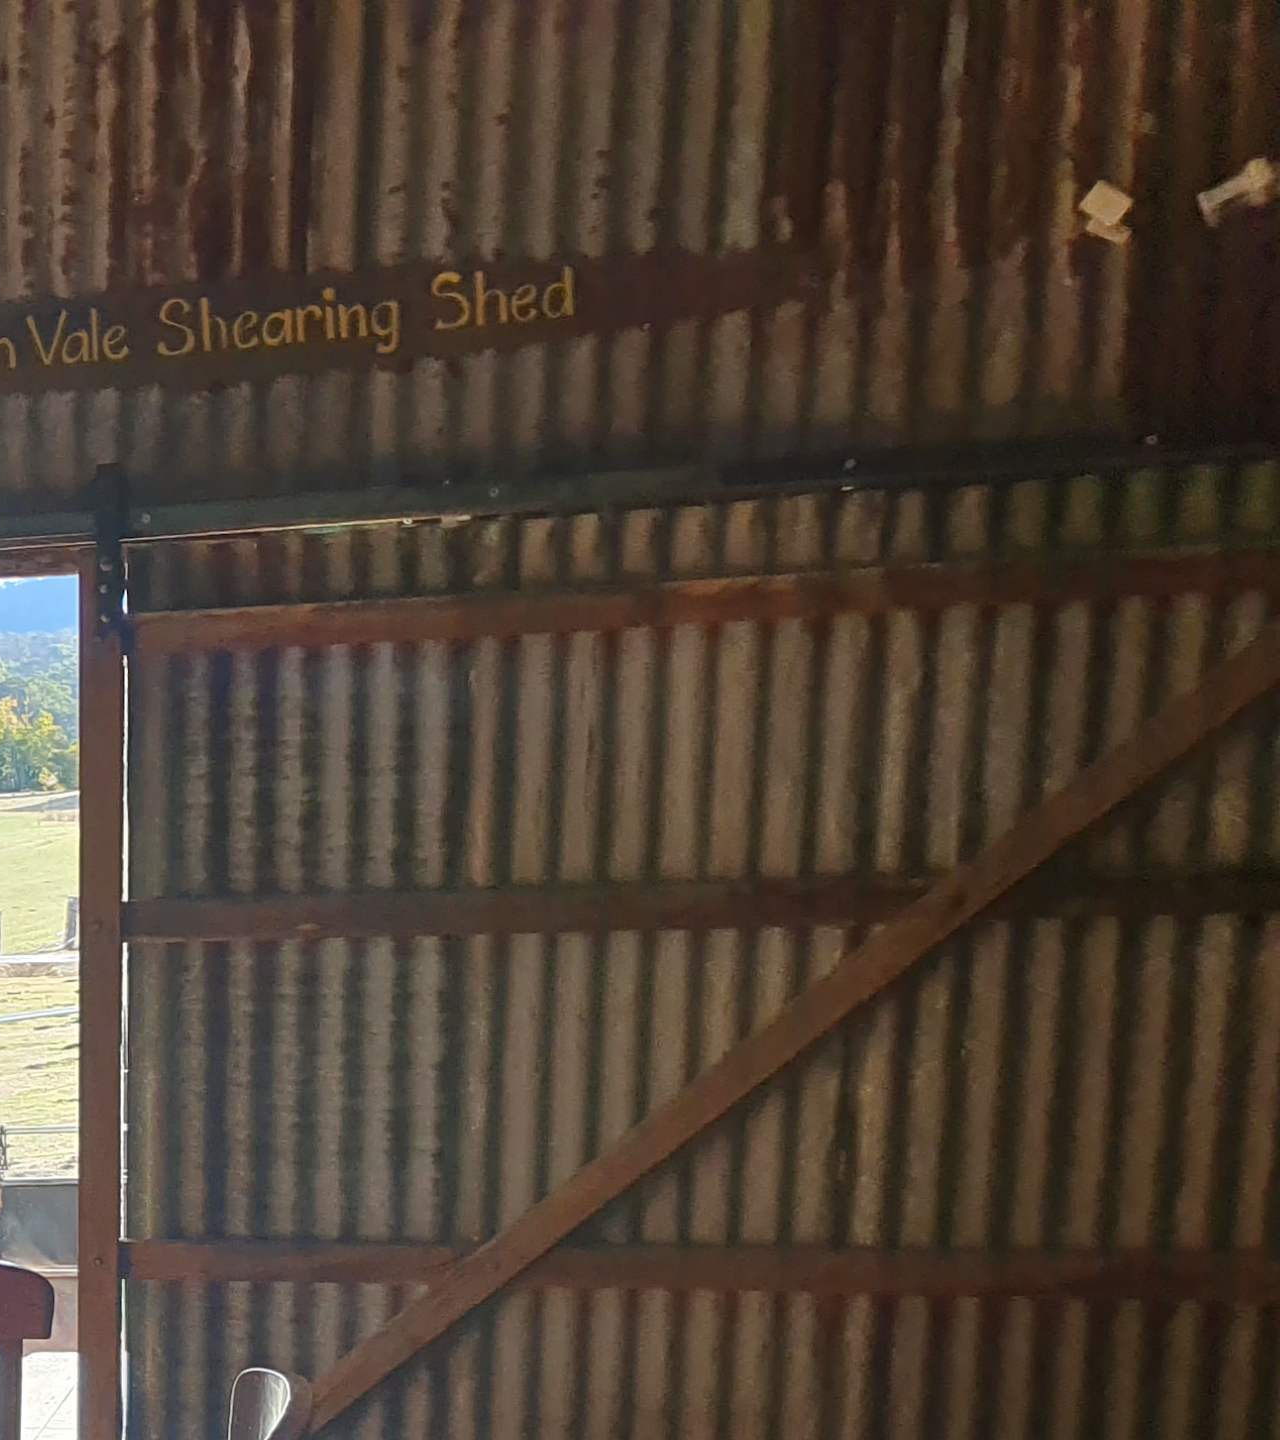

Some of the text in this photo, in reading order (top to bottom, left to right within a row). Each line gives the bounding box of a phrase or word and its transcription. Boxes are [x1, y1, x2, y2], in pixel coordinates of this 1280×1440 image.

[25, 307, 129, 366] Vale
[156, 286, 400, 356] Shearing
[431, 265, 577, 331] Shed
